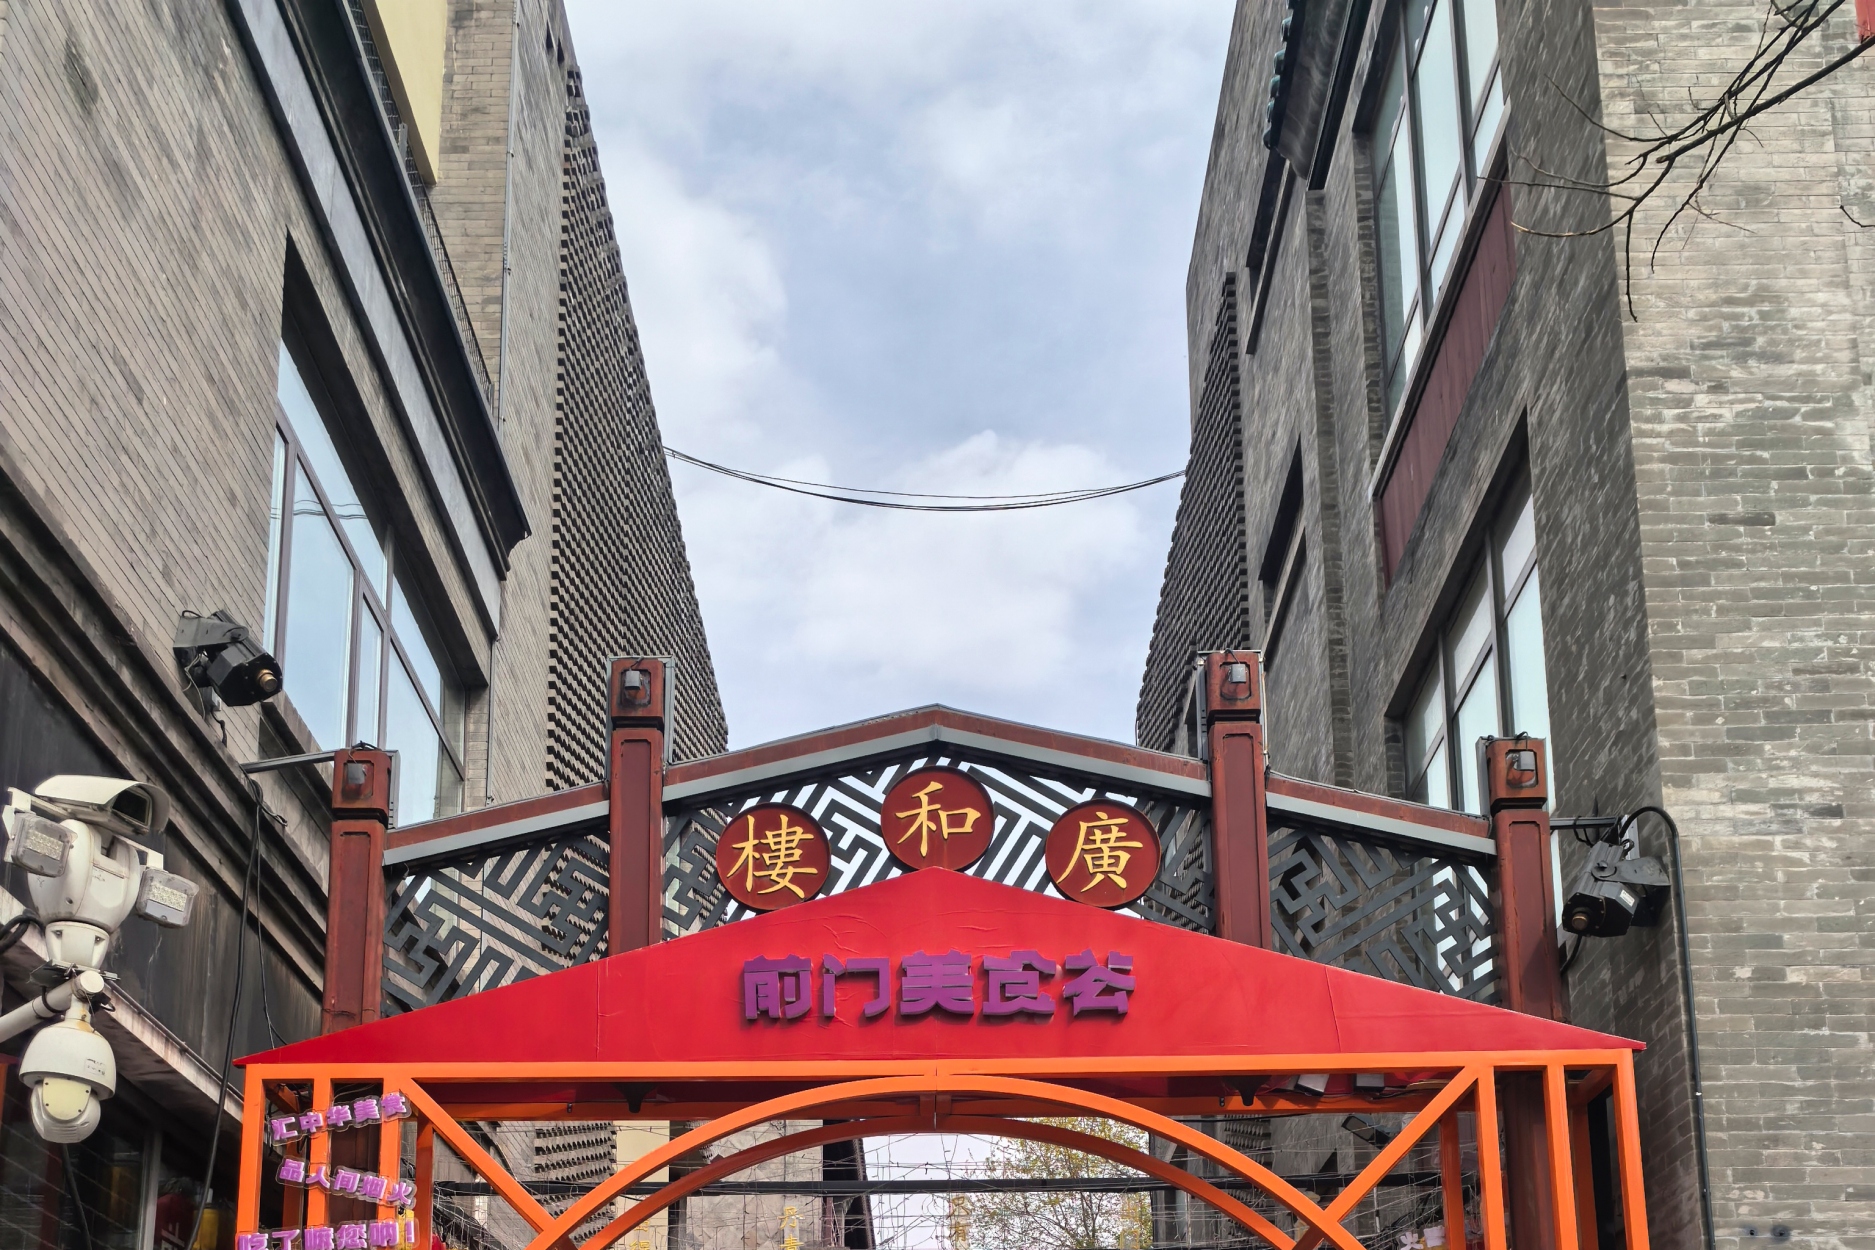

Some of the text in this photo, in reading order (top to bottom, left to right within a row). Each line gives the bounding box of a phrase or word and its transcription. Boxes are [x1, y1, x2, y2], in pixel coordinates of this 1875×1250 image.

[726, 780, 1143, 899] 廣 和 樓
[270, 1093, 406, 1141] 汇中华美食
[279, 1158, 412, 1205] 品人间烟火
